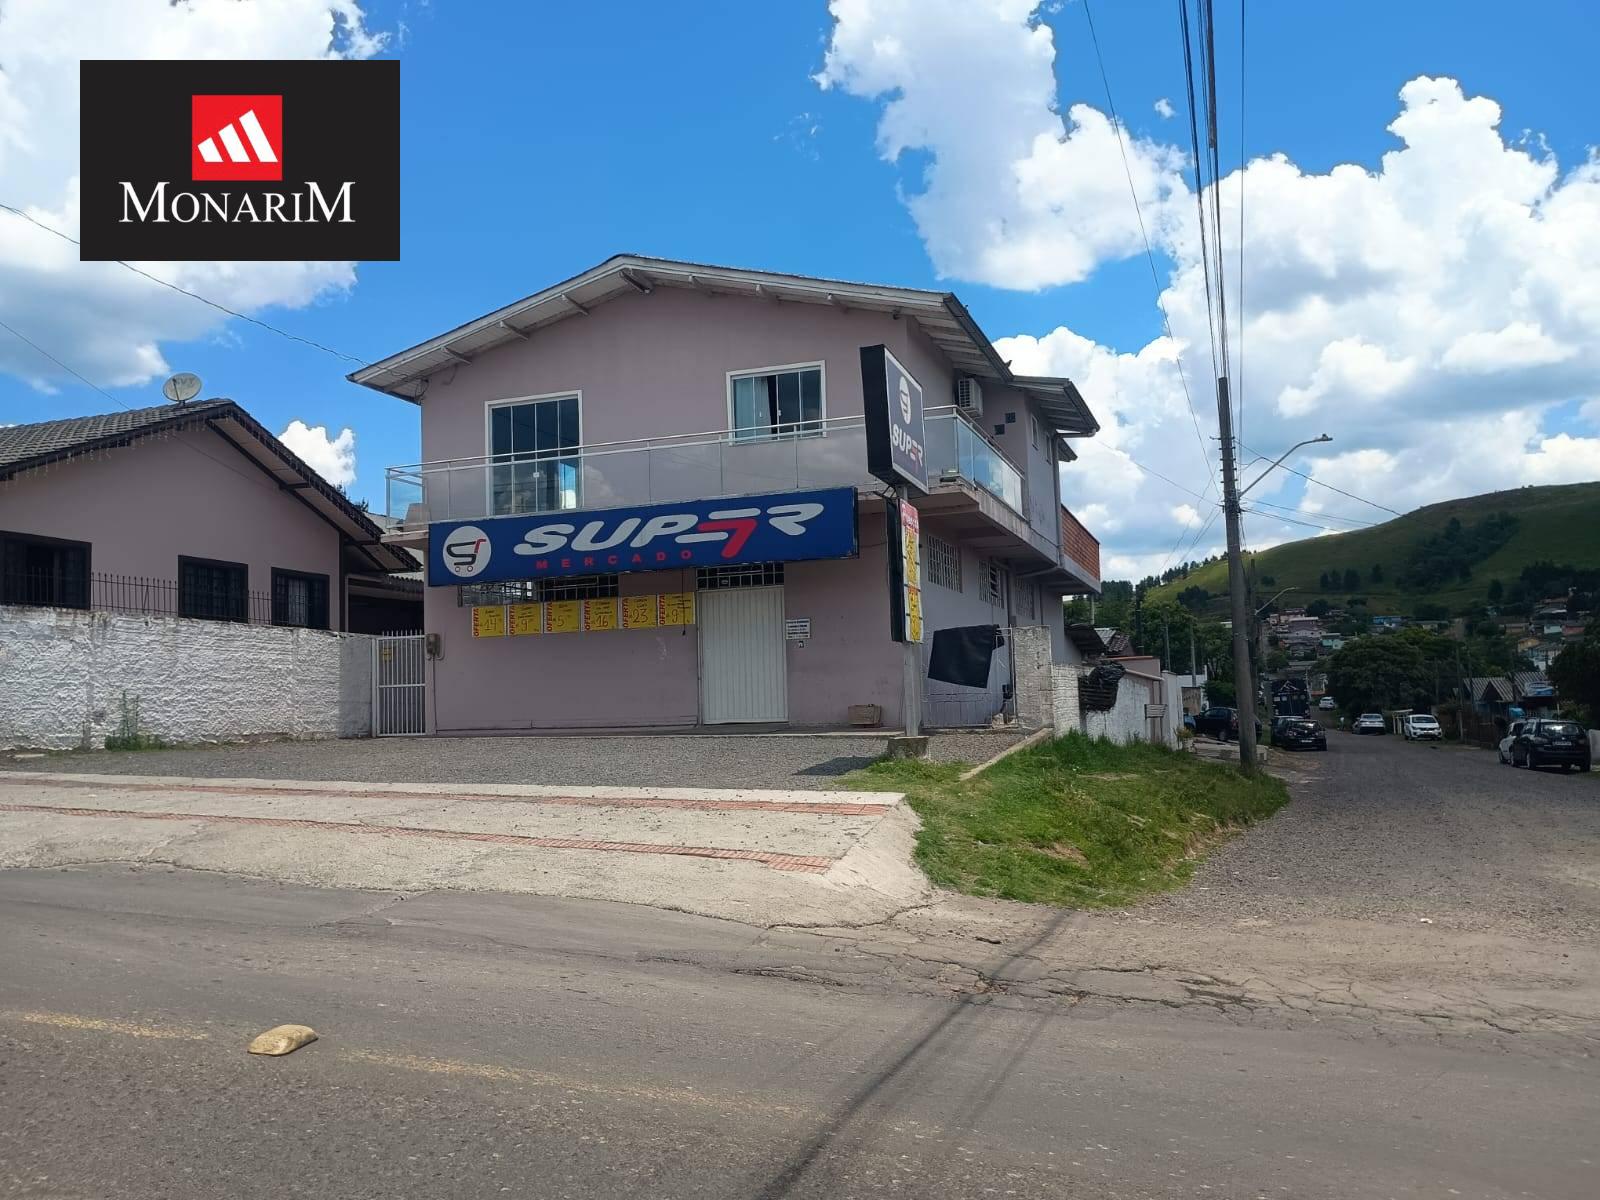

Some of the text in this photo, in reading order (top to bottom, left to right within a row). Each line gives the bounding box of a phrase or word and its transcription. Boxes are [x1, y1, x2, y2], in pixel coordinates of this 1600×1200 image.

[892, 423, 924, 468] SUPER
[535, 549, 692, 569] MERCADO
[632, 608, 648, 624] 23
